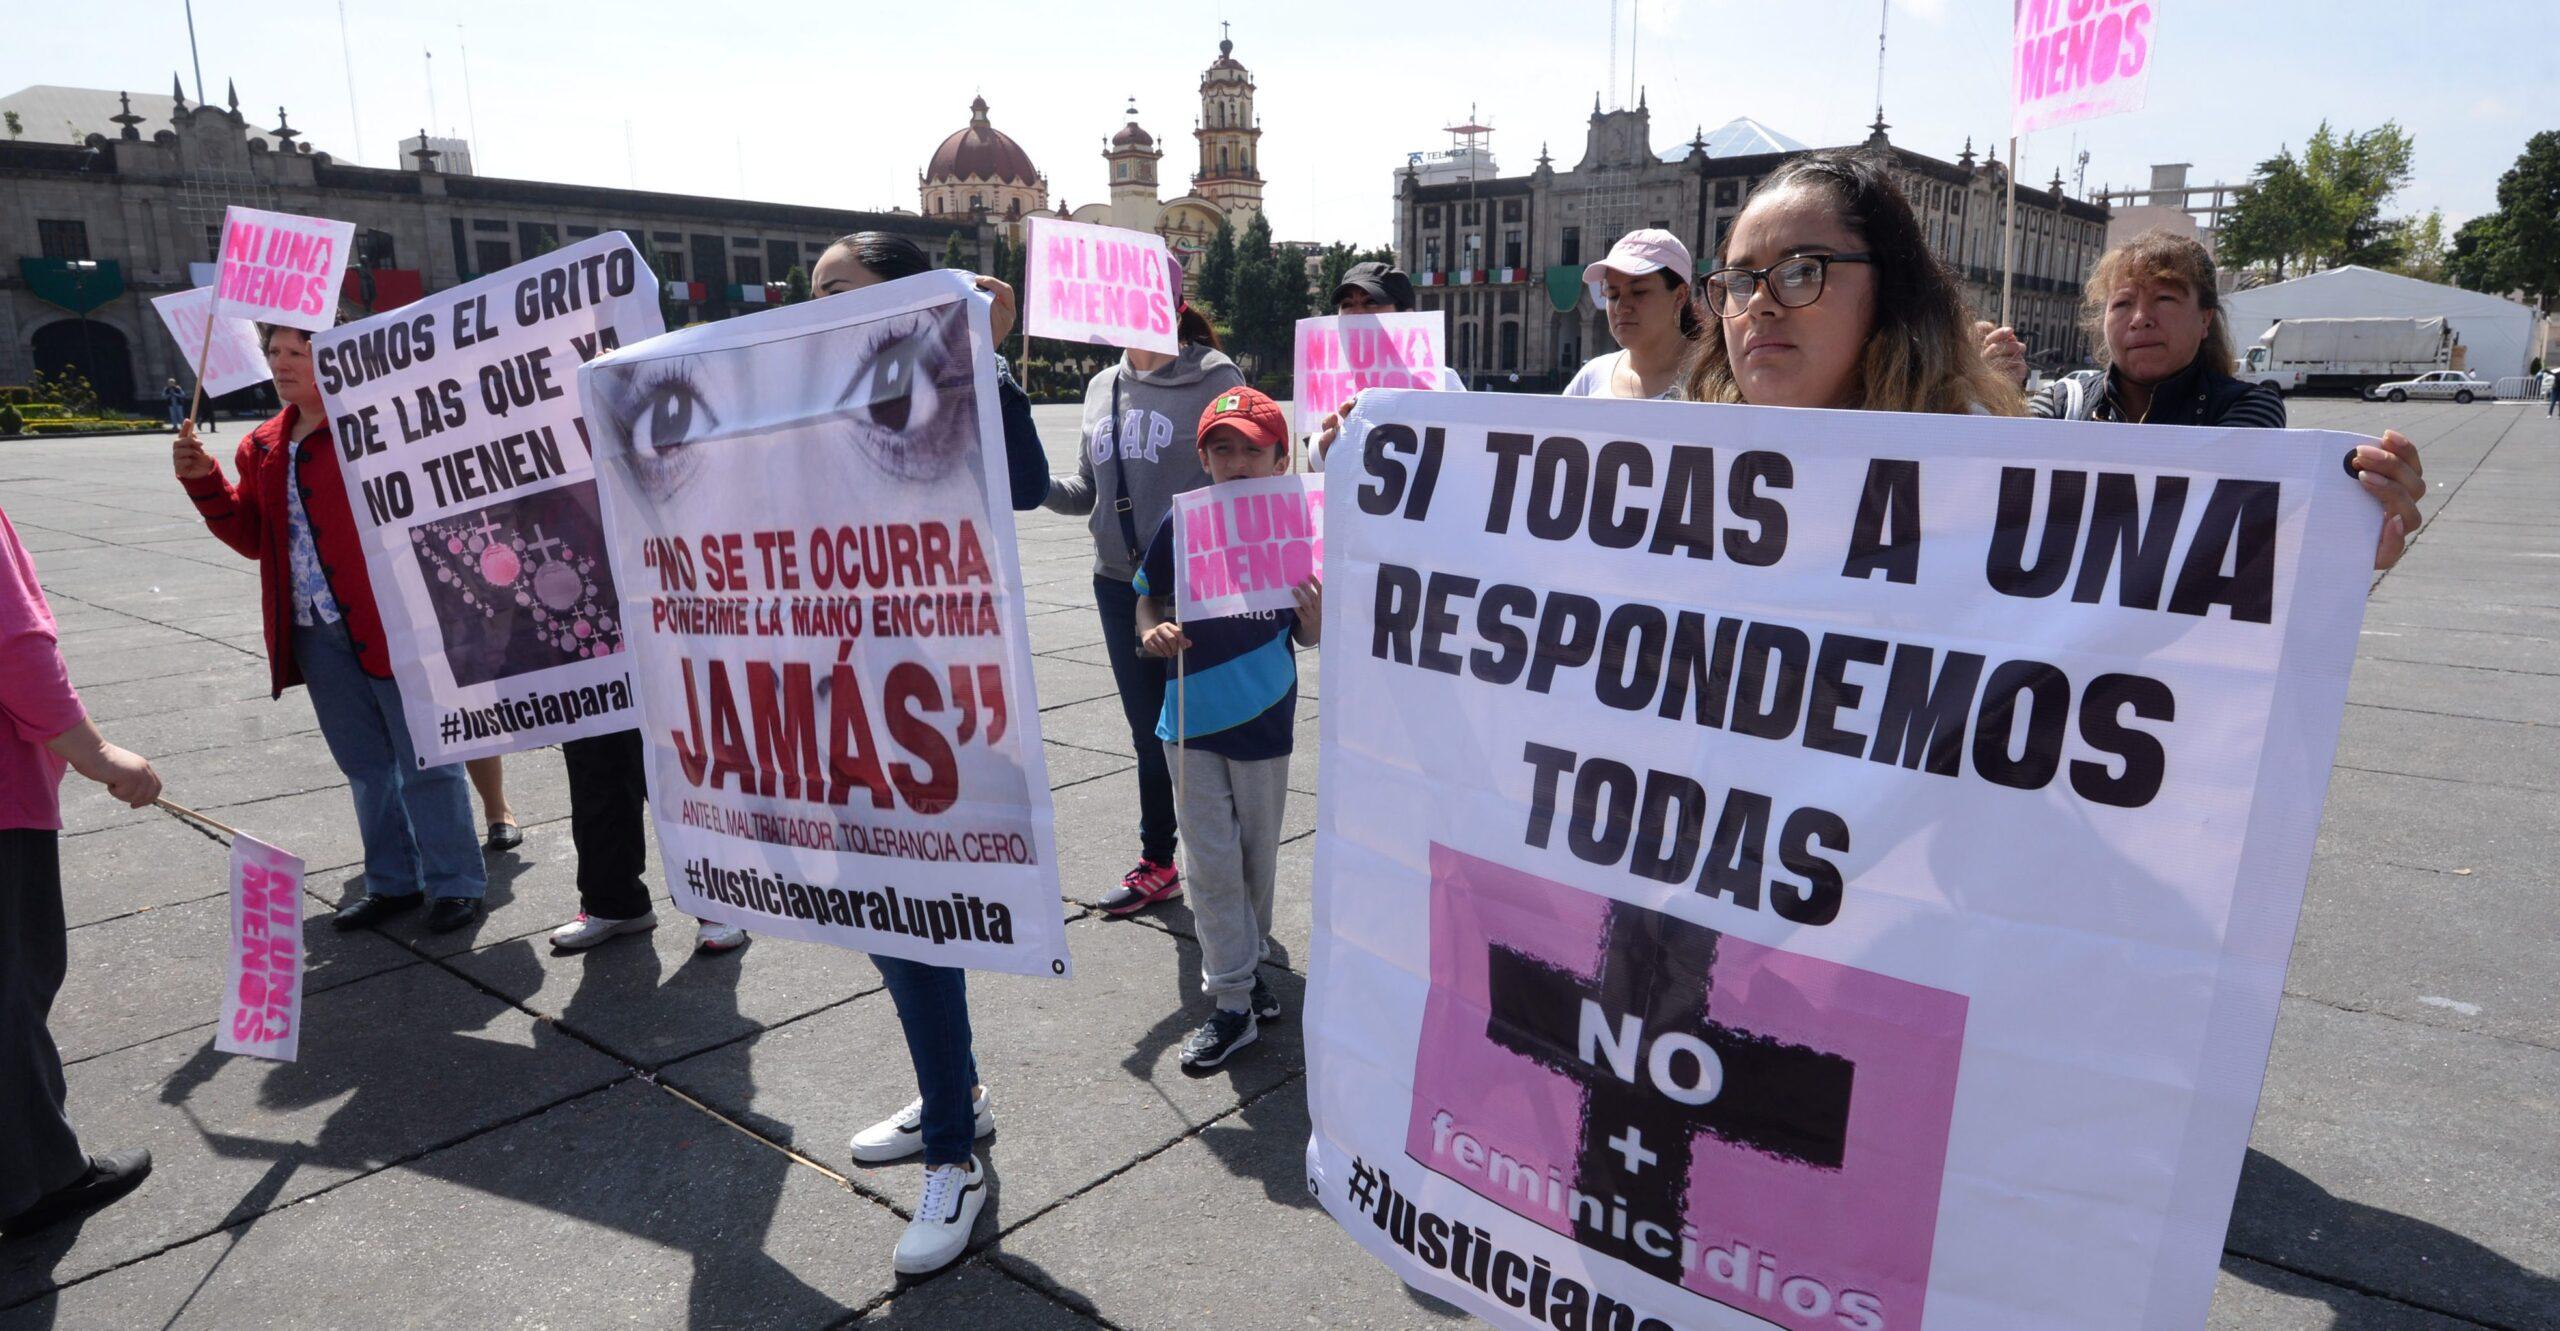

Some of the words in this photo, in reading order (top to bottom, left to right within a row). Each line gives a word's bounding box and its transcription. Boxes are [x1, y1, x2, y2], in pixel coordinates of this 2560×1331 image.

[2020, 3, 2151, 105] MENOS
[1426, 148, 1468, 160] TELMEX
[218, 261, 328, 316] MENOS
[225, 220, 265, 264] NI
[265, 228, 333, 277] UNA
[1048, 235, 1088, 279] NI
[1095, 239, 1165, 292] UNA
[318, 313, 436, 396] SOMOS
[452, 294, 499, 350] EL
[514, 247, 636, 328] GRITO
[1049, 279, 1171, 335] MENOS
[1306, 328, 1340, 371] NI
[1349, 327, 1435, 371] UNA
[336, 404, 388, 464] DE
[391, 378, 467, 445] LAS
[478, 346, 565, 418] QUE
[1090, 408, 1174, 466] GAP
[361, 469, 415, 527] NO
[421, 425, 567, 509] TIENEN
[700, 533, 748, 593] SE
[753, 530, 800, 592] TE
[809, 519, 994, 590] OCURRA
[1185, 501, 1228, 554] NI
[1357, 423, 1446, 522] SI
[1484, 430, 1795, 568] TOCAS
[1840, 457, 1921, 585] A
[1985, 465, 2281, 625] UNA
[651, 596, 750, 636] PONERME
[754, 596, 785, 637] LA
[791, 596, 863, 638] MANO
[872, 590, 1002, 638] ENCIMA
[1372, 562, 2176, 809] RESPONDEMOS
[682, 799, 713, 830] ANTE
[711, 805, 726, 834] EL
[839, 823, 961, 863] TOLERANCIA
[962, 832, 1033, 866] CERO.
[1523, 740, 1850, 927] TODAS
[268, 869, 296, 928] NI
[684, 857, 1015, 945] #JusticiaparaLupita
[233, 861, 270, 1044] MENOS
[263, 935, 296, 1043] UNA
[1577, 999, 1724, 1106] NO
[1429, 1107, 1886, 1331] feminicidios
